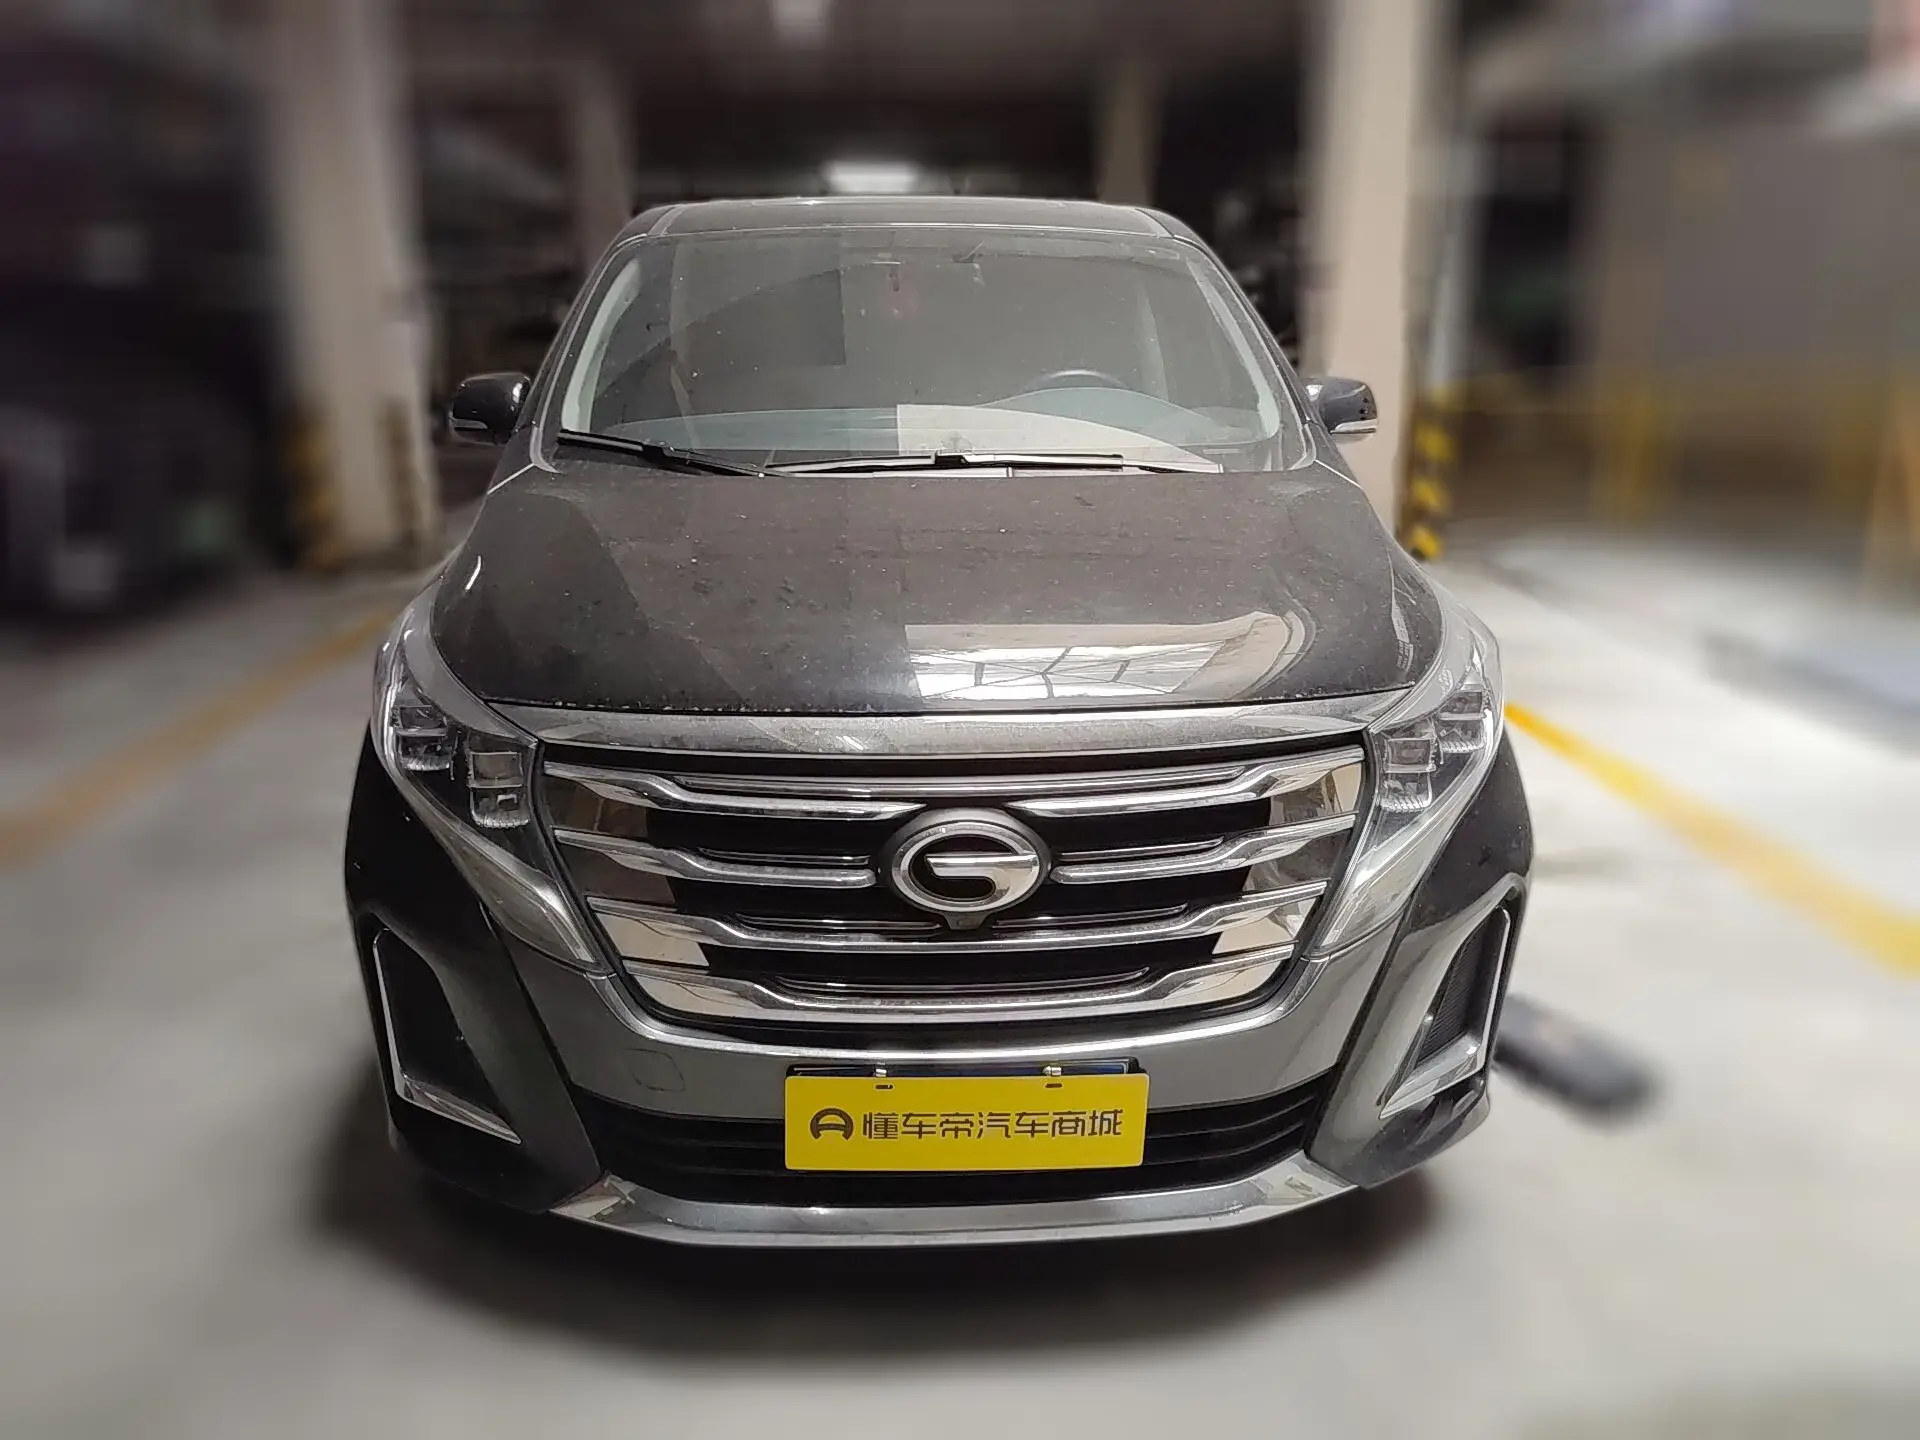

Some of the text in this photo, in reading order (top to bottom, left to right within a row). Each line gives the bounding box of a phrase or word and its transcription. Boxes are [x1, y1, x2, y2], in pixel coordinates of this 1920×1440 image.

[862, 1108, 1124, 1140] 懂车帝汽车商城
